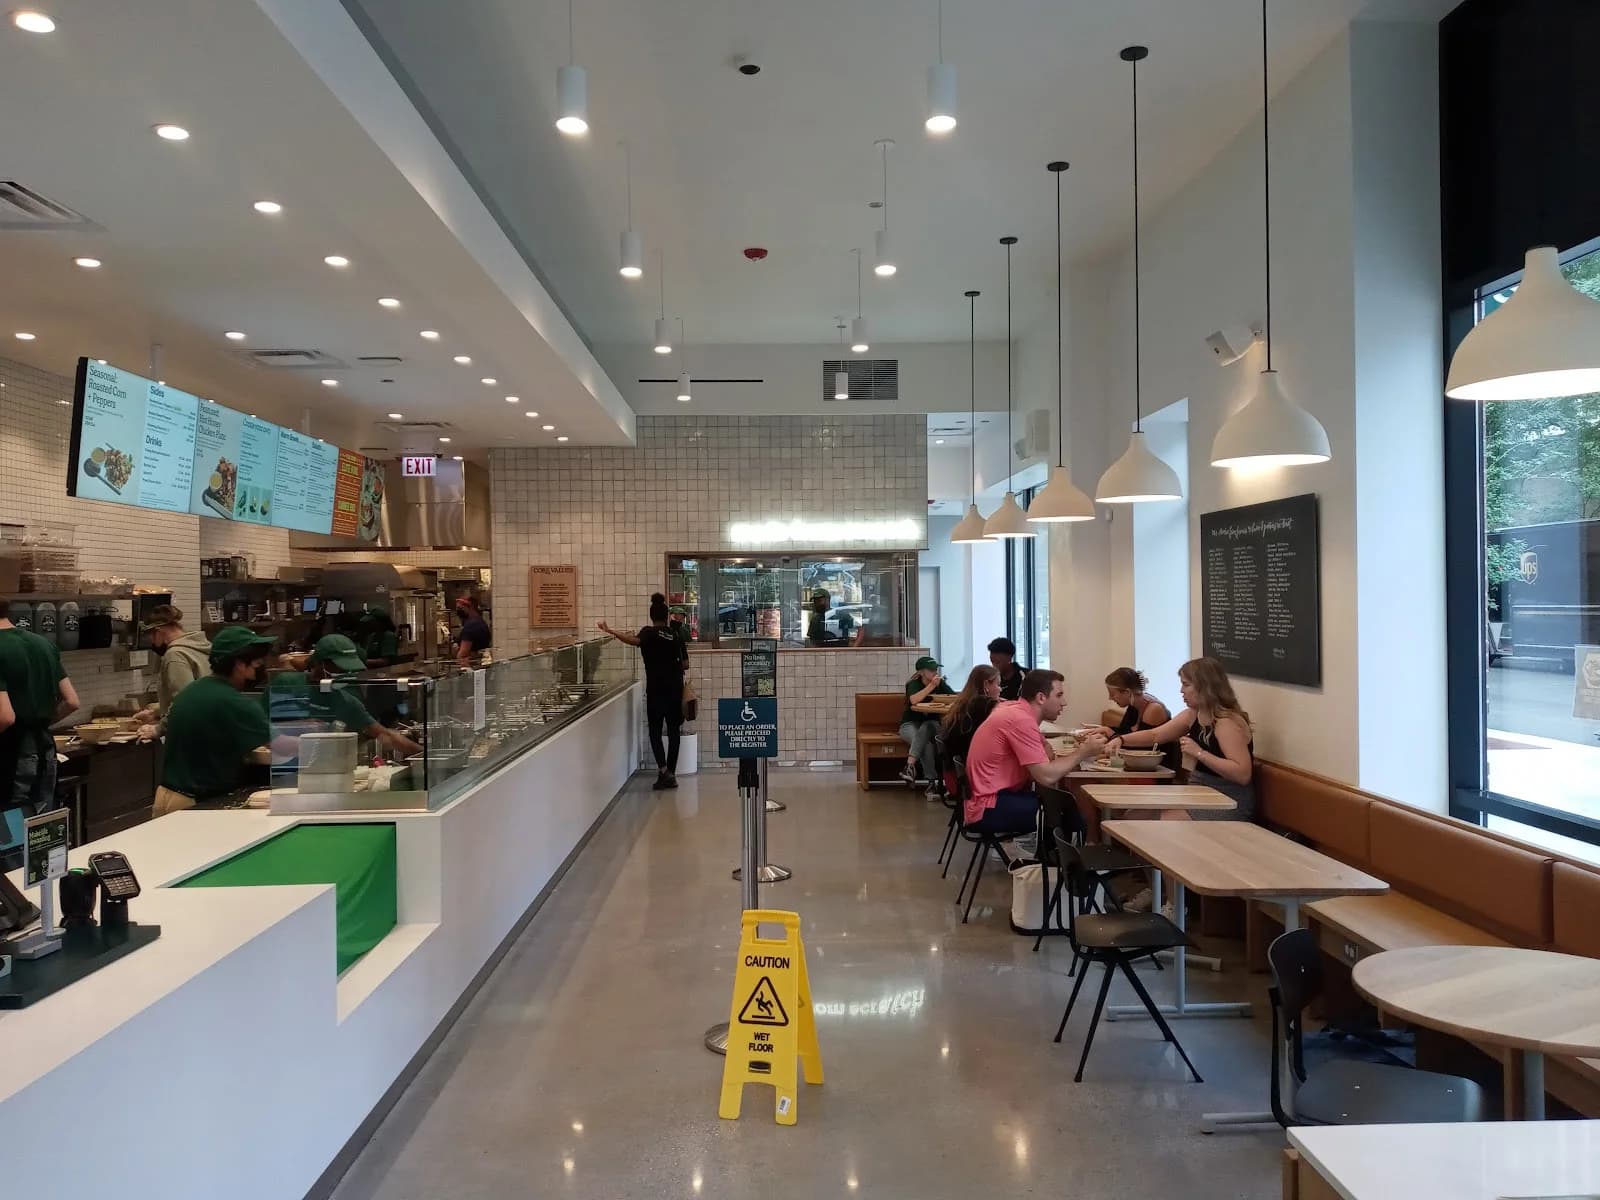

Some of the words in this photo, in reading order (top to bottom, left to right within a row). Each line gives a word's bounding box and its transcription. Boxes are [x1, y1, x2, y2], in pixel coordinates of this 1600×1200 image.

[88, 378, 113, 395] Roasted
[113, 385, 127, 399] Corn
[150, 385, 165, 398] Sides
[92, 392, 116, 409] Peppers
[145, 434, 163, 447] Drinks
[406, 458, 433, 474] EXIT
[1523, 561, 1537, 579] ups
[745, 955, 790, 969] CAUTION
[753, 1032, 771, 1042] WET
[748, 1042, 774, 1053] FLOOR
